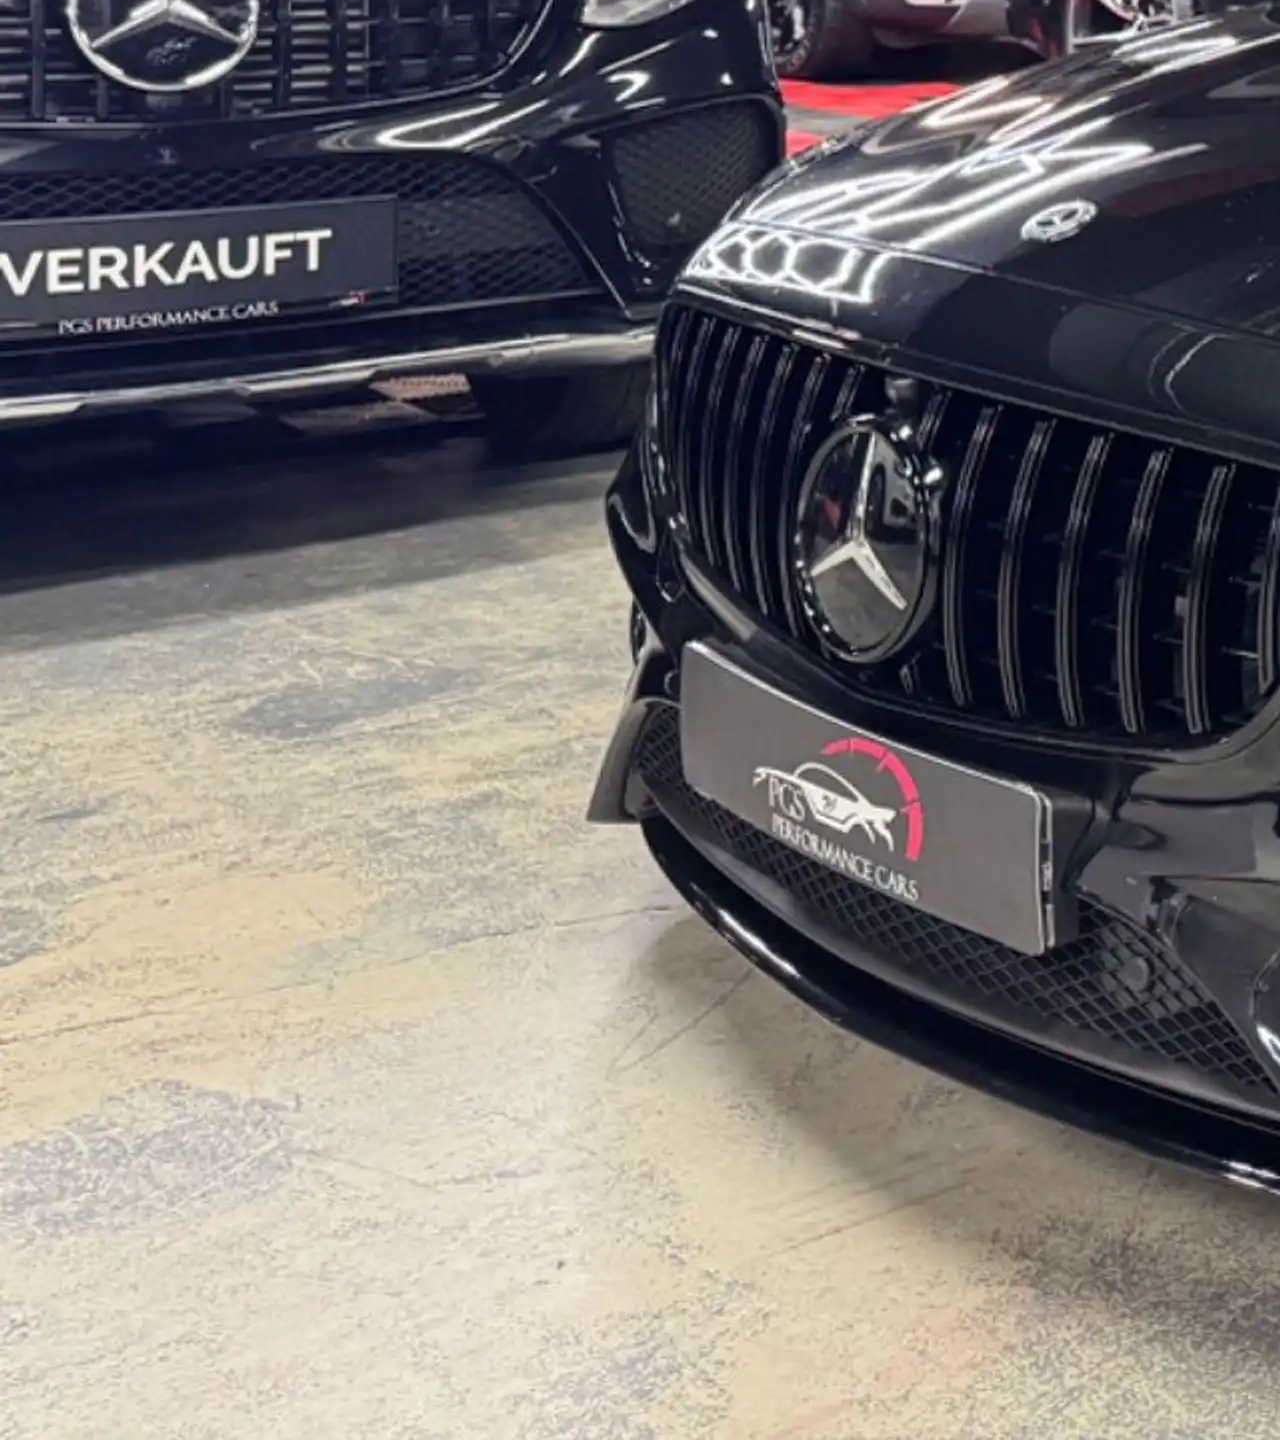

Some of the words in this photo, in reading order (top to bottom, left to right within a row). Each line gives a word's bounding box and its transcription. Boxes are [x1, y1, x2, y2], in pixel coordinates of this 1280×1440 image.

[0, 228, 333, 297] VERKAUFT
[58, 318, 93, 335] PGS
[96, 306, 229, 332] PERFORMANCE
[231, 300, 279, 320] CARS
[771, 812, 873, 883] PERFORMANCE
[875, 865, 920, 903] CARS
